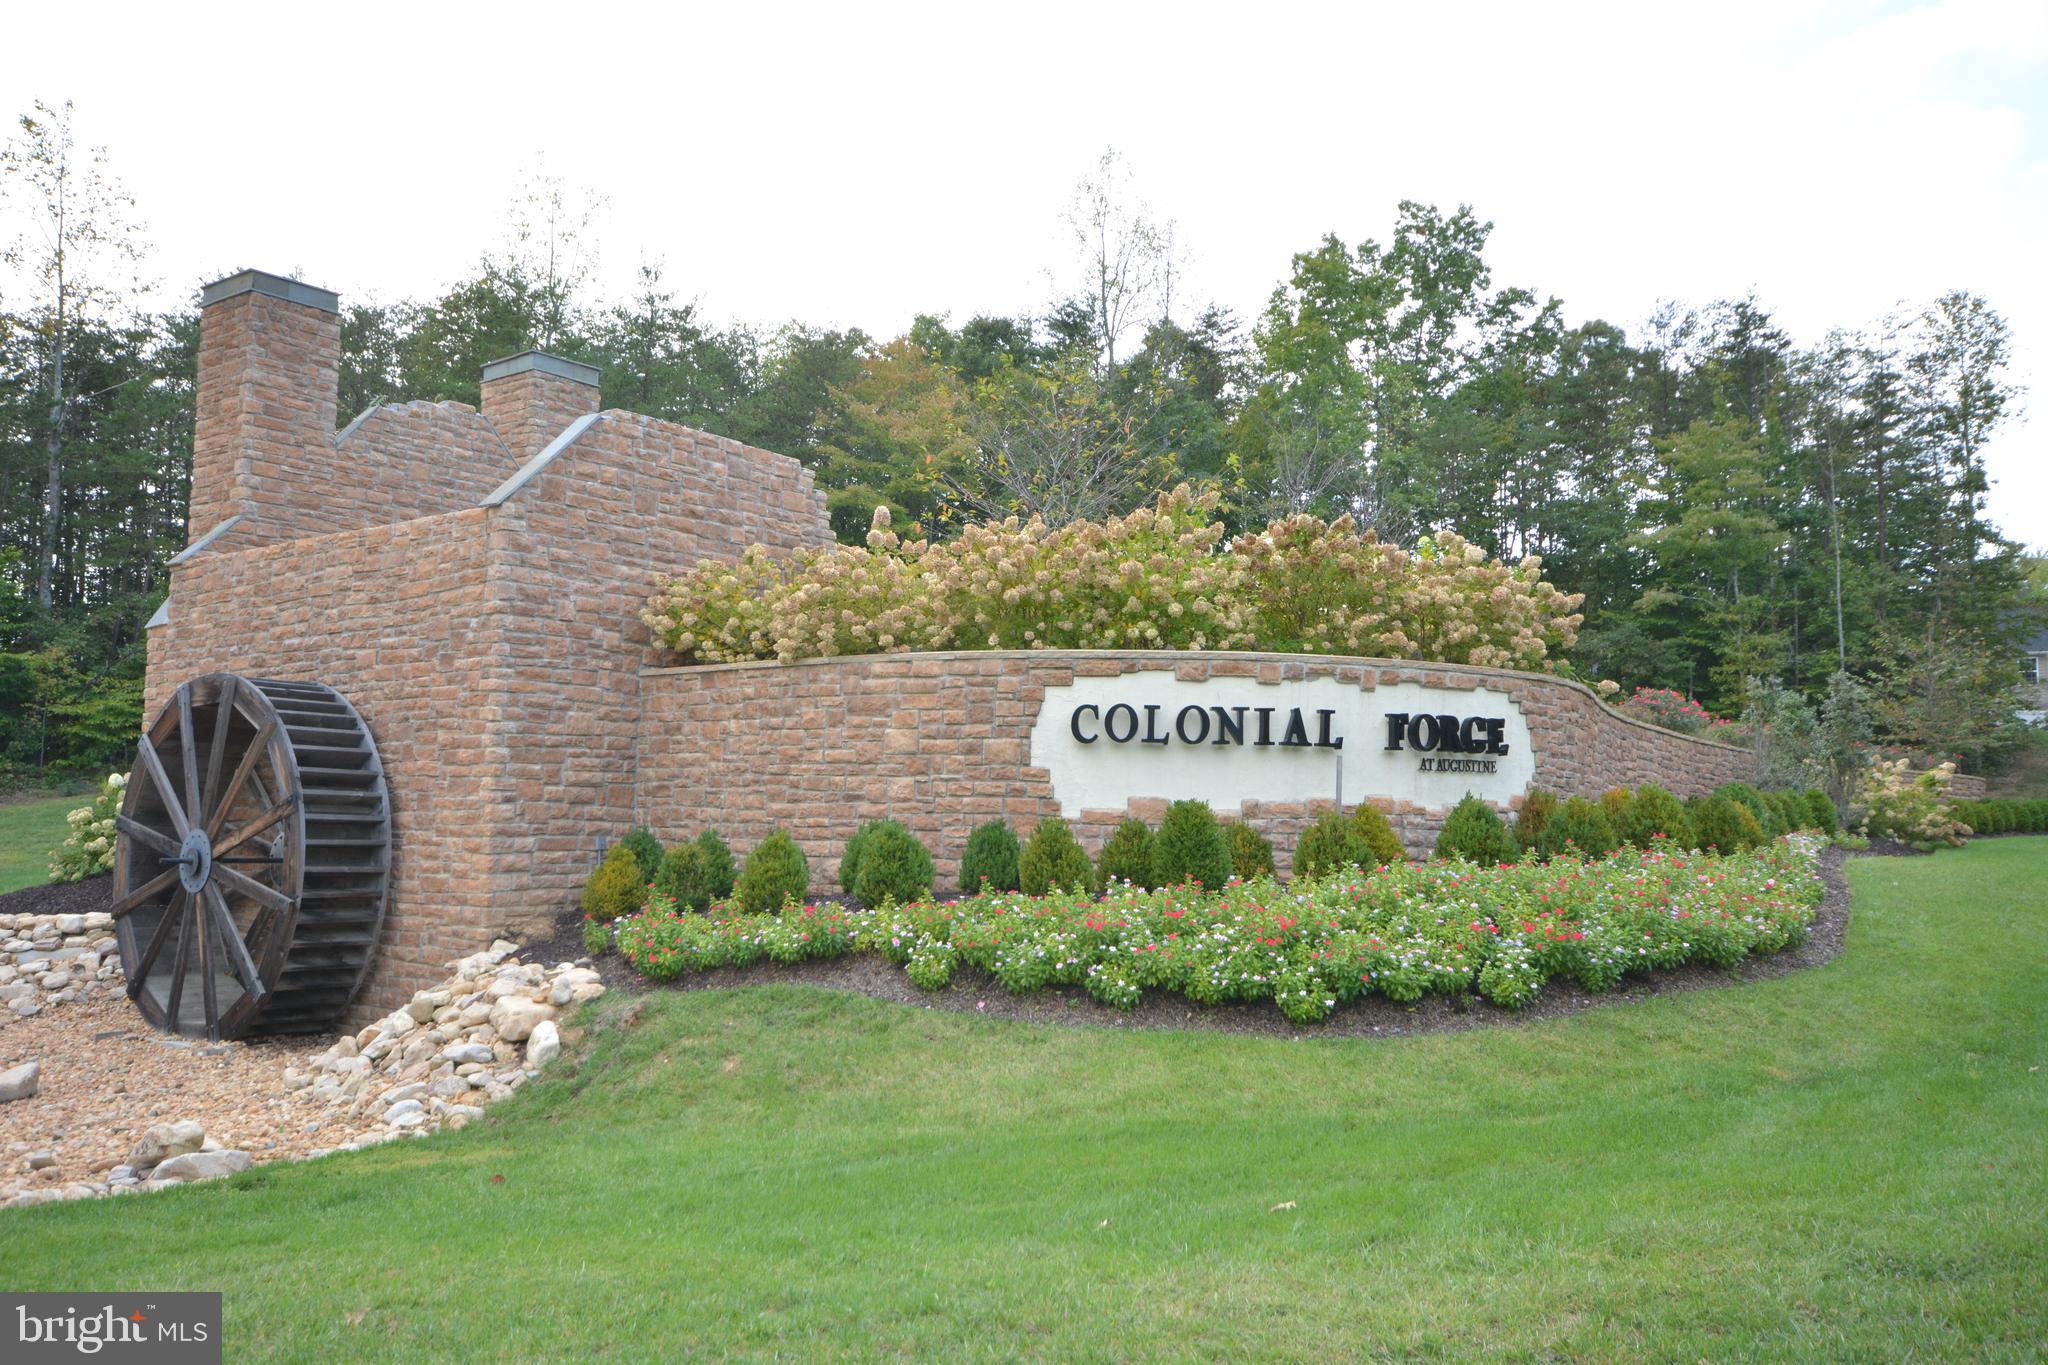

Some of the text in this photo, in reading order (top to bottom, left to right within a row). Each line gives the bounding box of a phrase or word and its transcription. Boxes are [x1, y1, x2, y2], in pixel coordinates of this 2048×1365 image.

[1070, 703, 1509, 756] COLONIAL FORGE
[1418, 757, 1497, 774] AT AUGUSTINE
